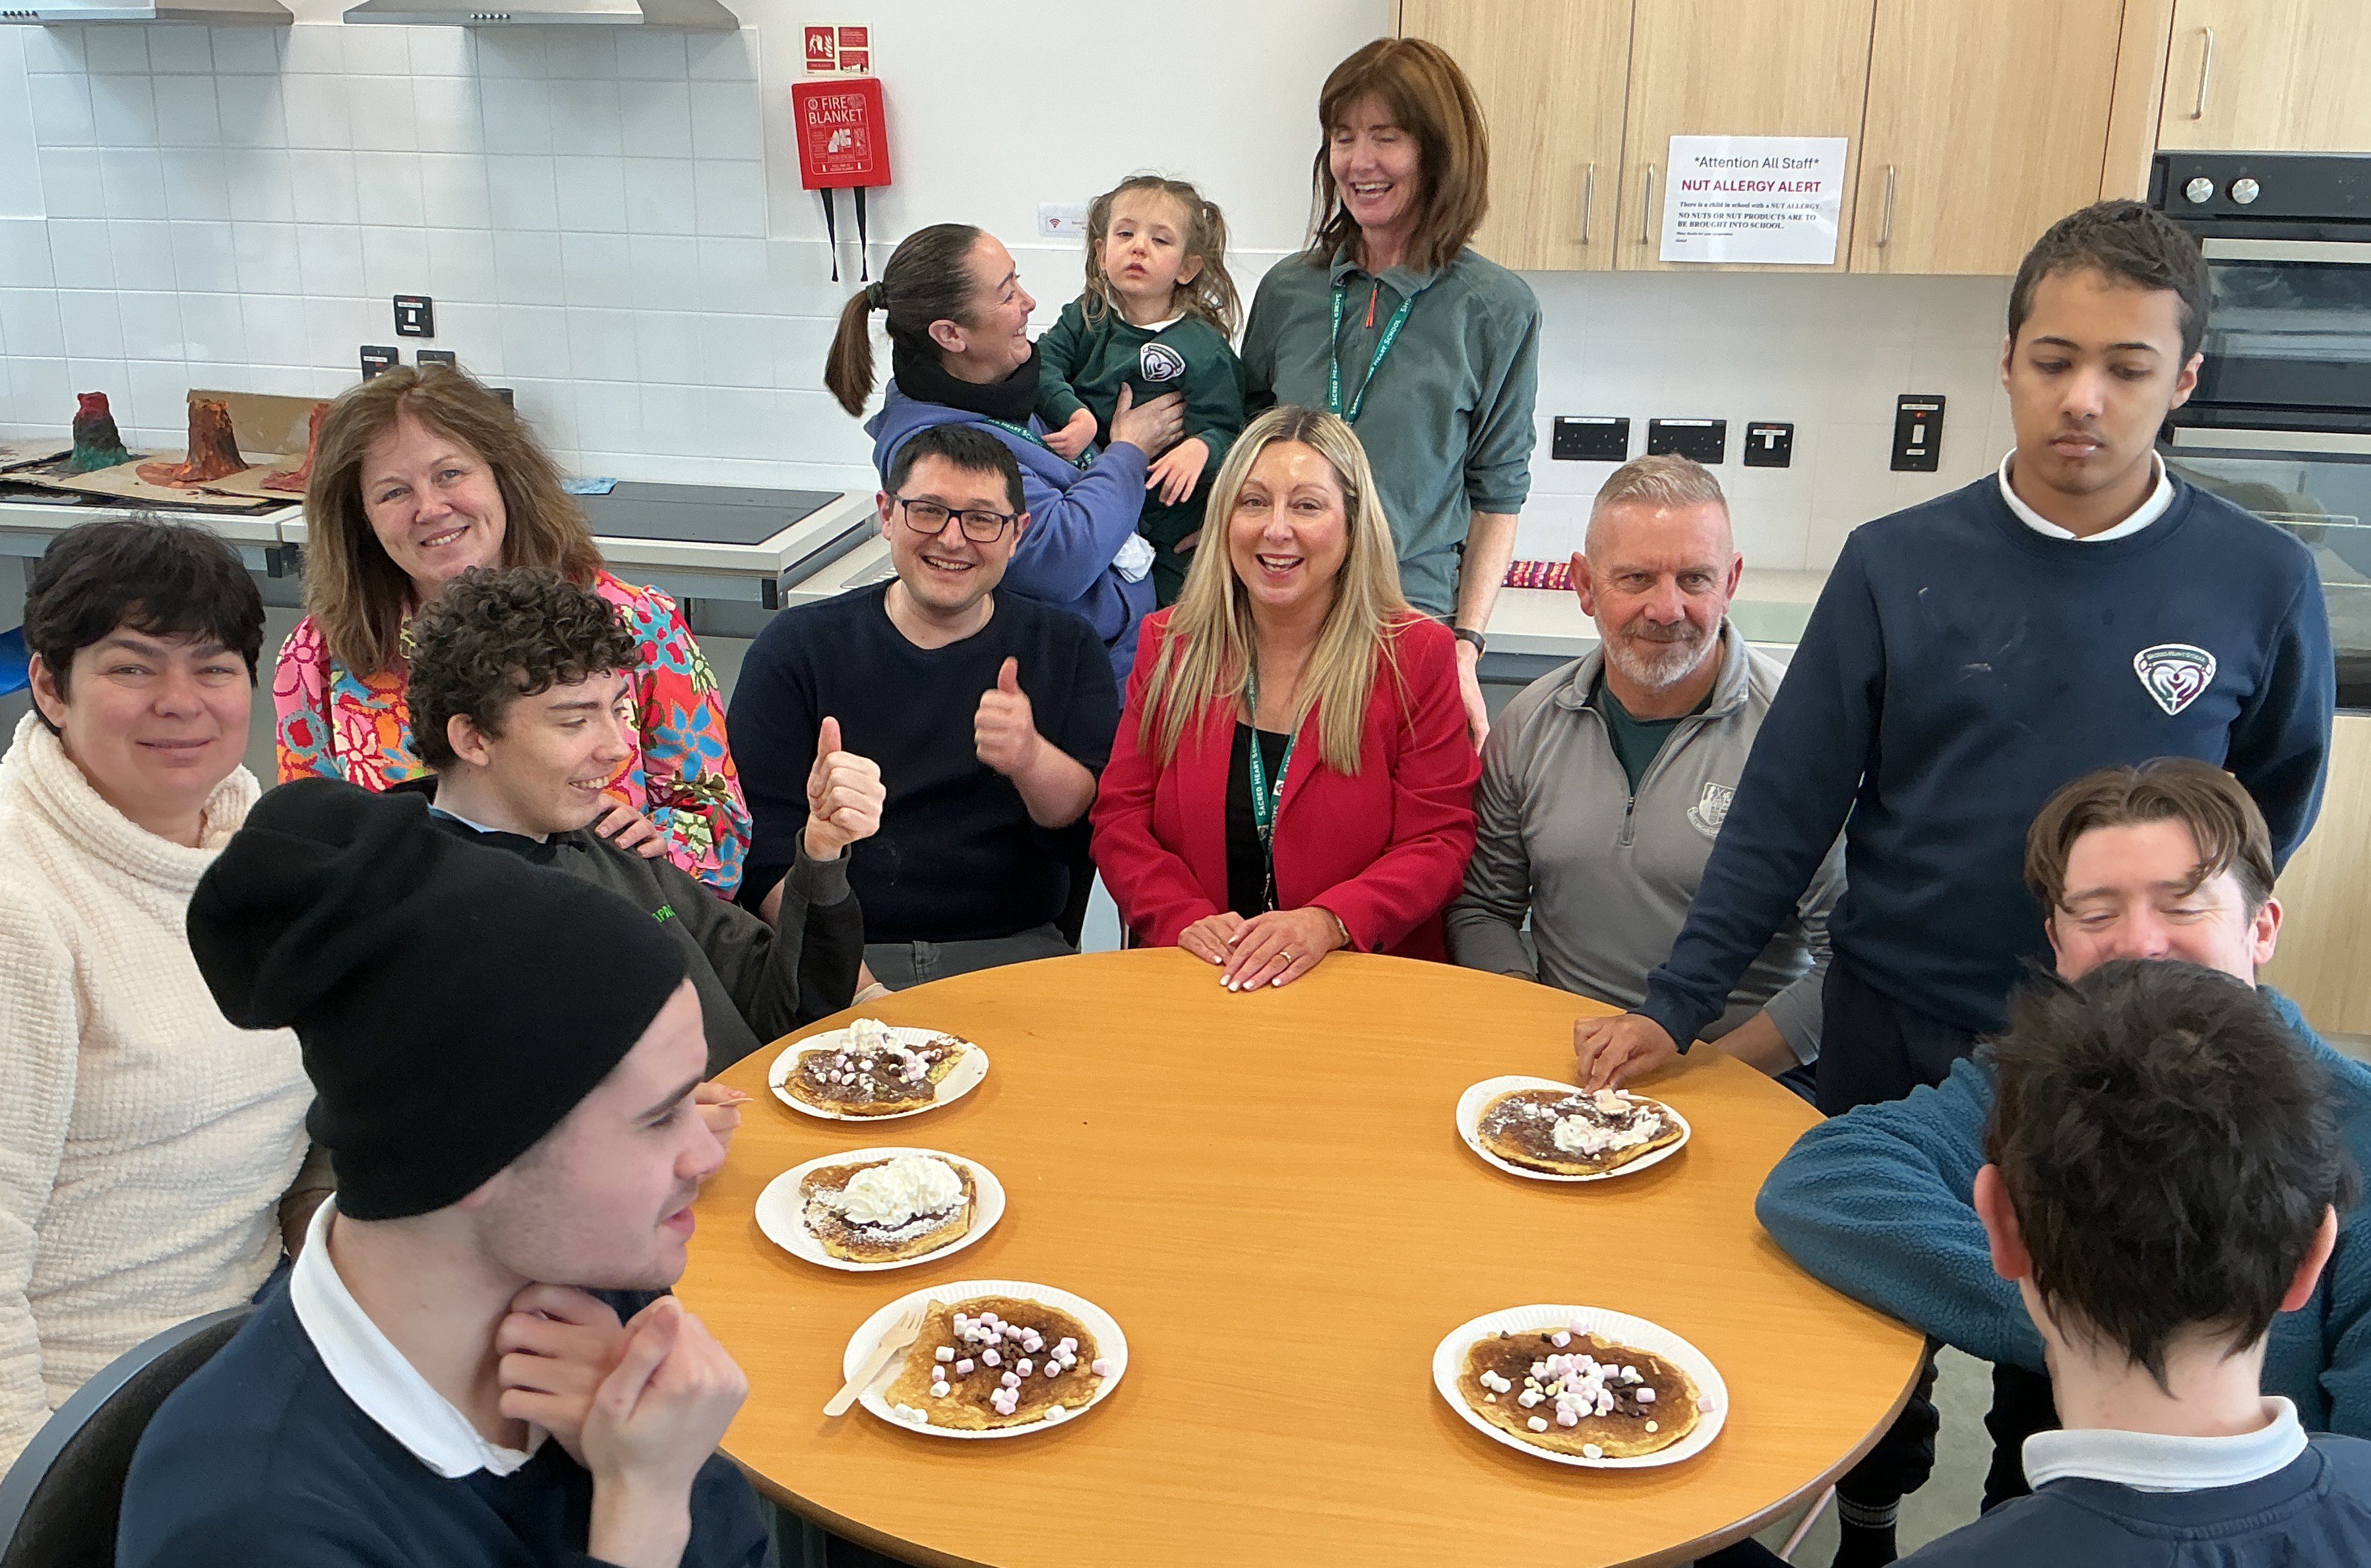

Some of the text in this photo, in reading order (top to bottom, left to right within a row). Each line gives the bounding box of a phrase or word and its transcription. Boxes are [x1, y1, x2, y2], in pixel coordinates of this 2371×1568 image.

[821, 96, 848, 110] FIRE
[808, 109, 863, 125] BLANKET
[1762, 157, 1779, 169] All
[1681, 180, 1821, 193] NUT ALLERGY ALERT
[1384, 319, 1401, 345] SCHOOL
[1253, 760, 1262, 785] HEART
[1258, 786, 1266, 816] SACRED
